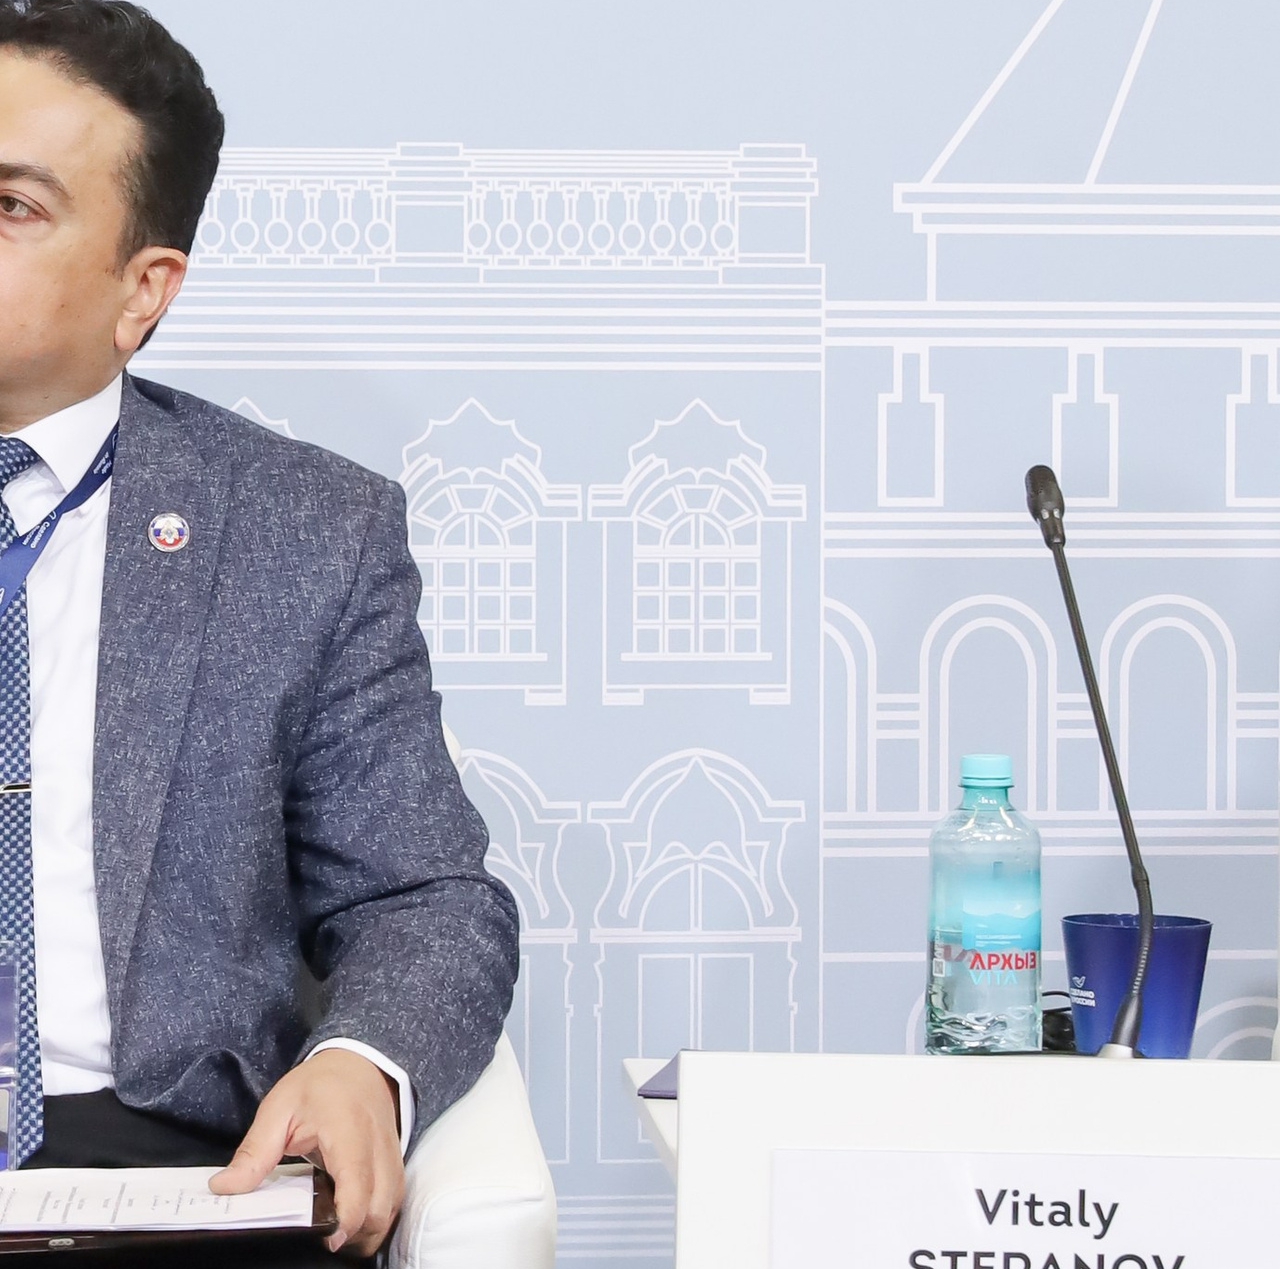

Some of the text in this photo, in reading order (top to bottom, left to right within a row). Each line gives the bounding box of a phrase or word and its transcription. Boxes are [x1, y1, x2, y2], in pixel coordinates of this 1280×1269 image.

[970, 952, 1036, 970] АРХЫЗ
[970, 970, 1017, 986] VITA
[975, 1188, 1119, 1240] Vitaly
